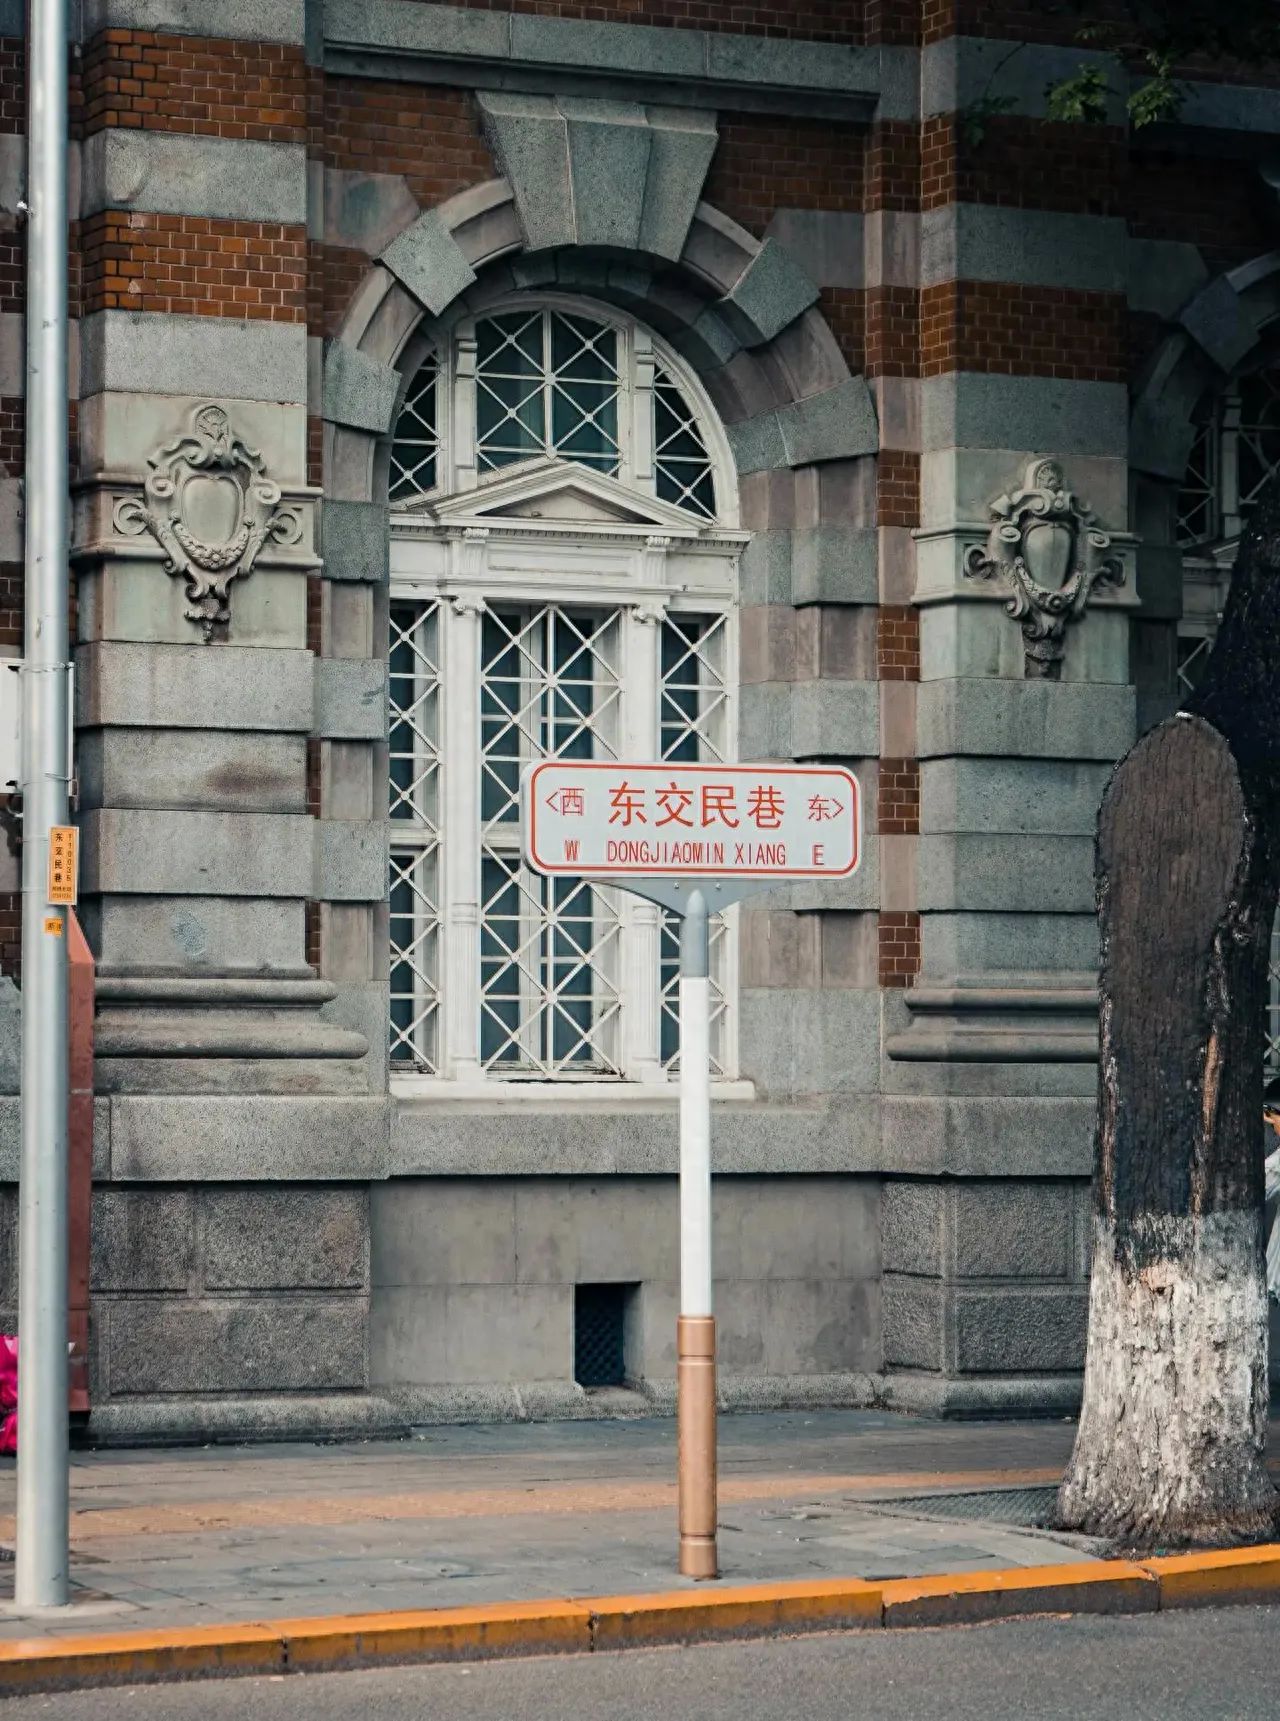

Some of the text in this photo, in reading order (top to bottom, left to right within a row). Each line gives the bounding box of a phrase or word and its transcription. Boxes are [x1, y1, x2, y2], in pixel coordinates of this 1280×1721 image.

[559, 787, 585, 817] 西
[608, 781, 785, 829] 东交民巷
[807, 793, 831, 822] 东
[54, 833, 63, 882] 东交民巷
[564, 839, 581, 862] W
[607, 840, 787, 866] DONGJIAOMIN XIANG
[812, 844, 825, 866] E
